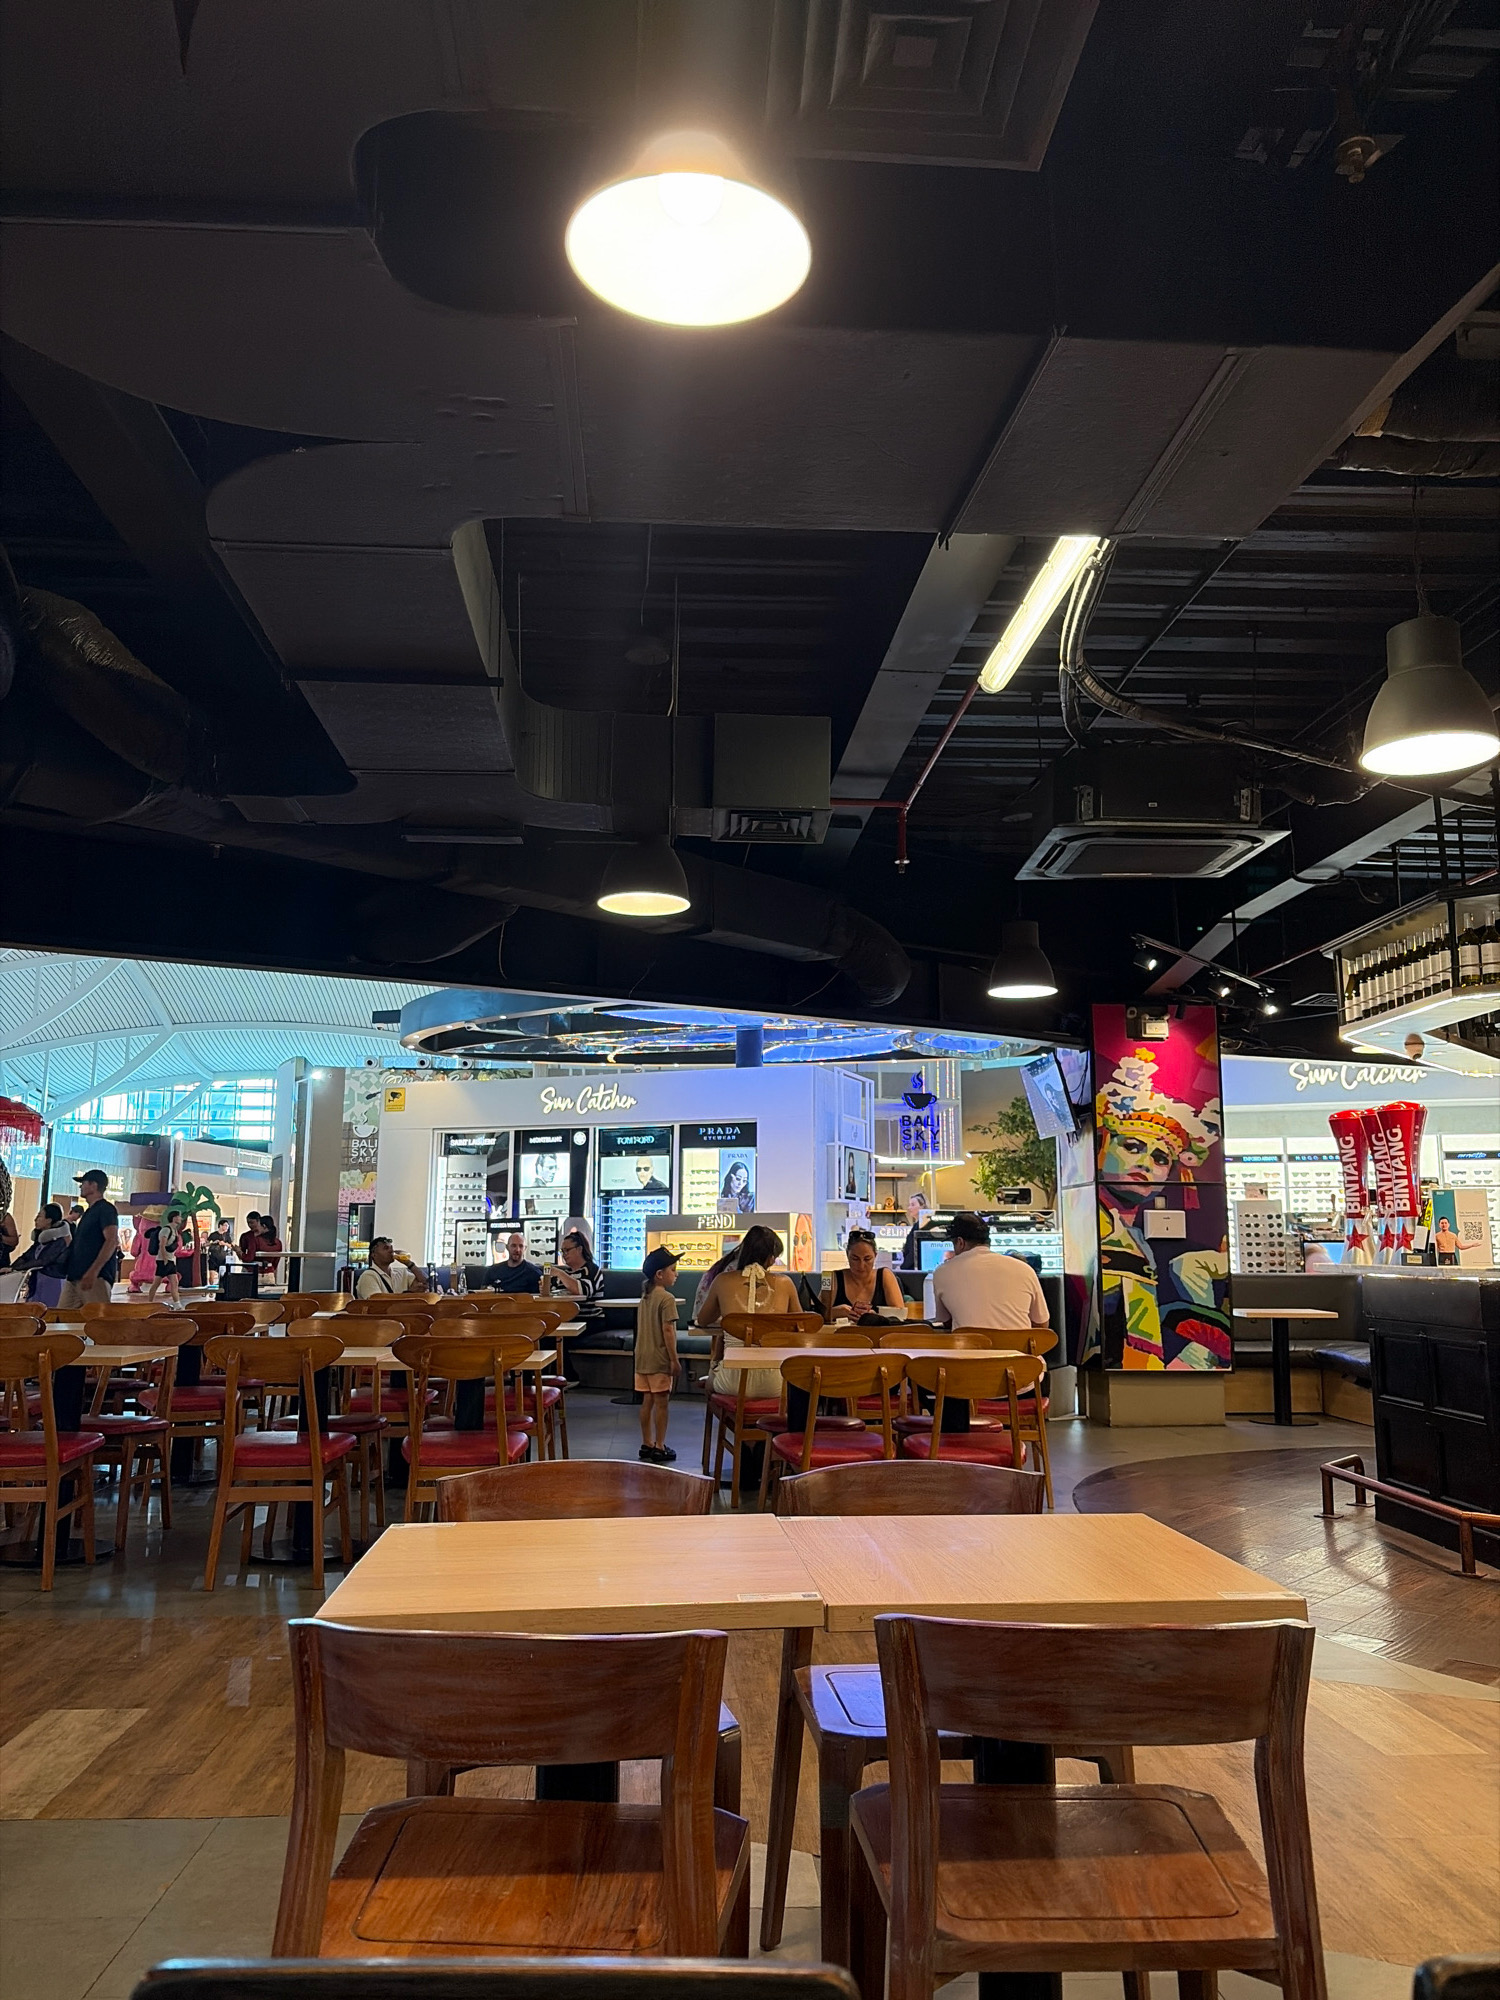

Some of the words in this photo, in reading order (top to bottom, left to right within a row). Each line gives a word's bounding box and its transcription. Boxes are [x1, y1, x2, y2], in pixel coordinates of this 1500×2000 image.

[1289, 1061, 1339, 1092] Sun
[540, 1086, 575, 1114] Sun
[576, 1082, 638, 1115] Catcher
[901, 1115, 940, 1127] BALI
[698, 1126, 741, 1135] PRADA
[902, 1129, 940, 1141] SKY
[351, 1139, 378, 1148] BALI
[616, 1136, 633, 1145] TOM
[634, 1135, 655, 1144] FORD
[351, 1147, 377, 1157] SKY
[350, 1156, 377, 1164] CAFE
[697, 1214, 736, 1229] FENDI
